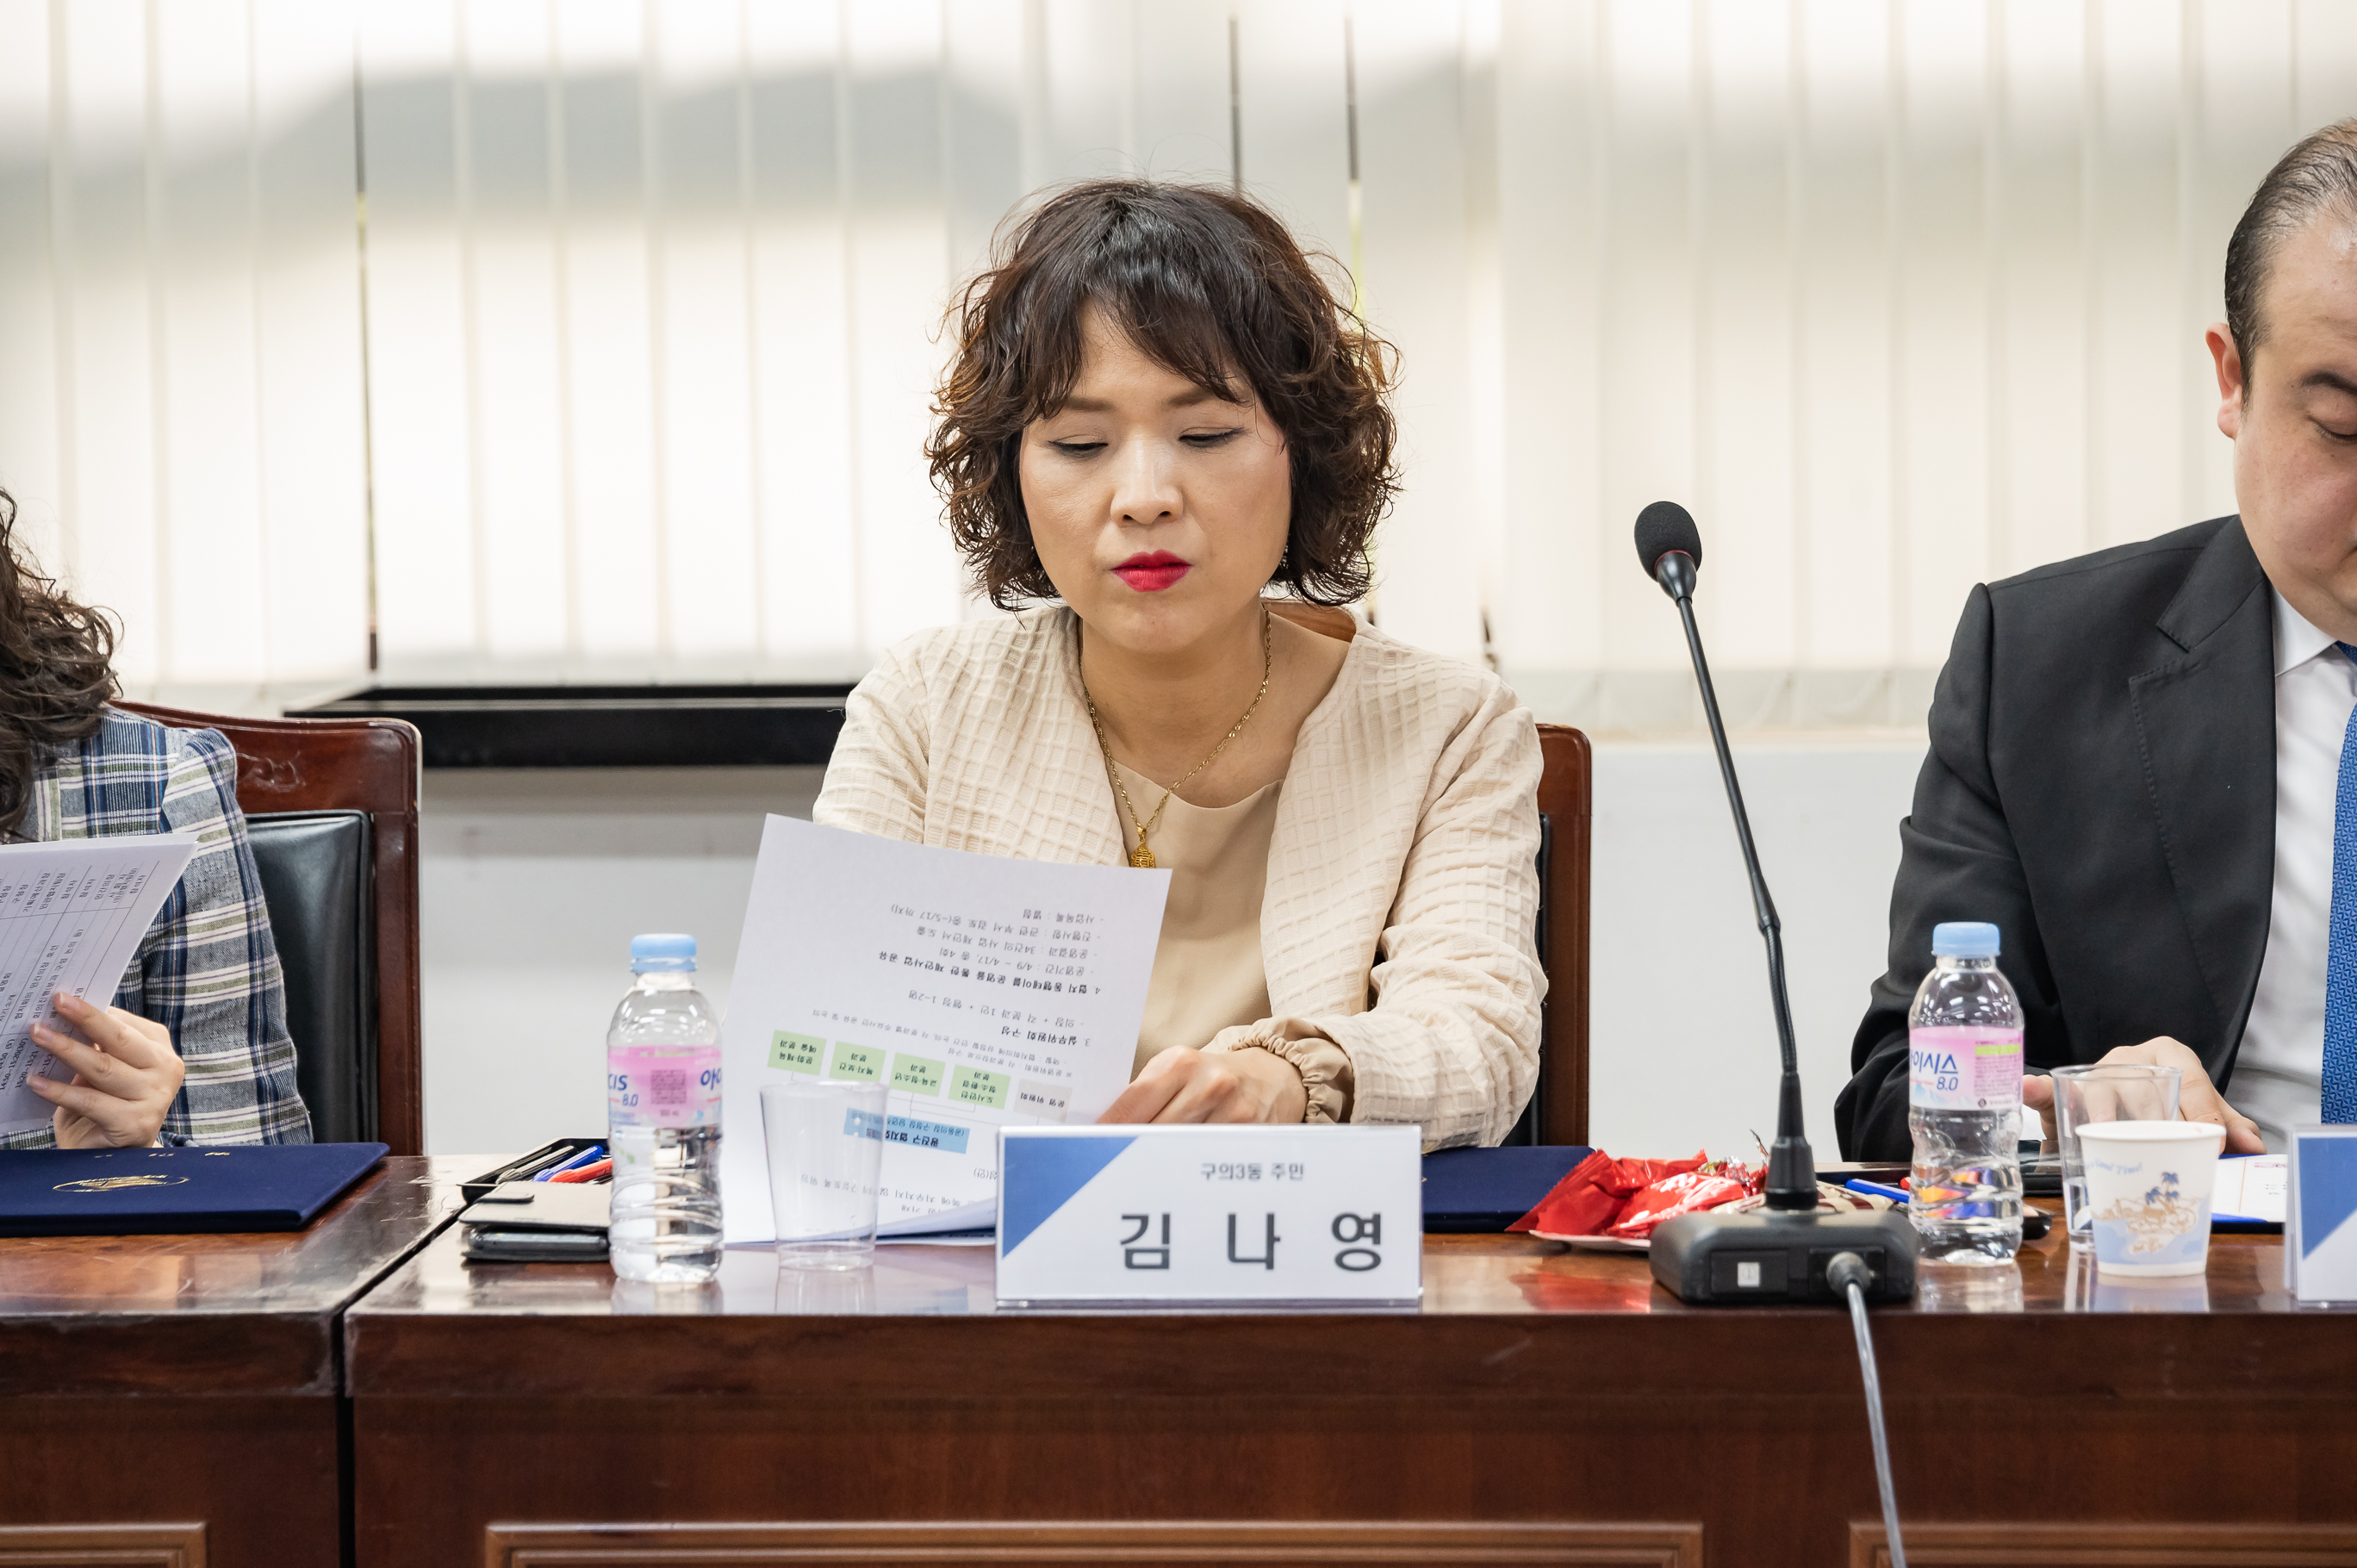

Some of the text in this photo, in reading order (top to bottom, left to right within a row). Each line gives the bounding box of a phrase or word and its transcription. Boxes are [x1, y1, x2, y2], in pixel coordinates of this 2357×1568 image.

[879, 950, 898, 962] 공유
[904, 955, 945, 973] 제안사업
[1068, 983, 1087, 994] 협치
[1054, 1017, 1075, 1028] 의장
[1001, 1025, 1021, 1037] 구성
[1027, 1030, 1077, 1046] 실무위원회
[1910, 1048, 1958, 1074] 이시스
[1937, 1076, 1958, 1091] 8.0
[912, 1134, 939, 1148] 광진구
[1200, 1162, 1304, 1181] 구의3동 주민
